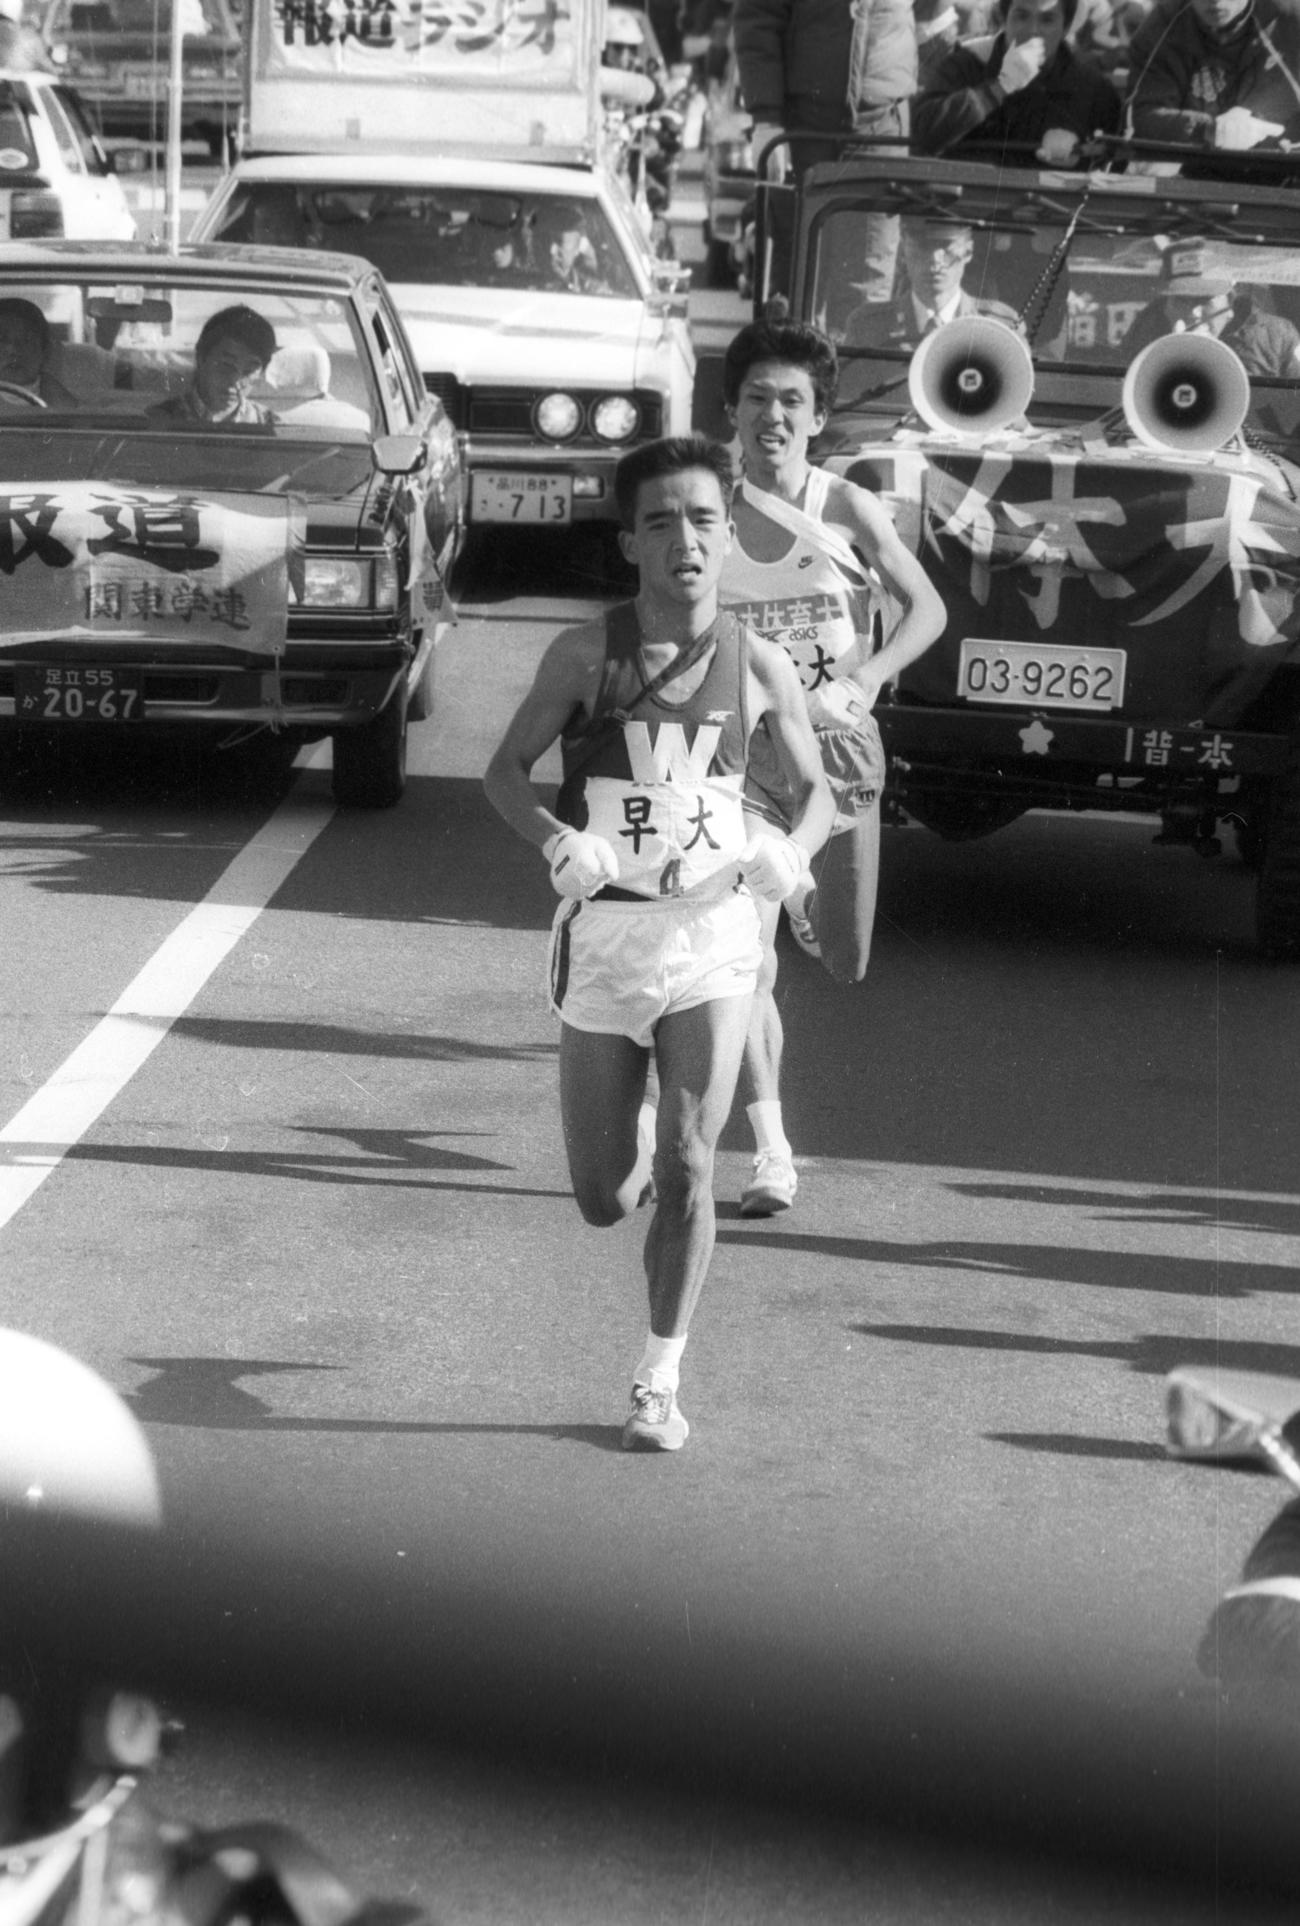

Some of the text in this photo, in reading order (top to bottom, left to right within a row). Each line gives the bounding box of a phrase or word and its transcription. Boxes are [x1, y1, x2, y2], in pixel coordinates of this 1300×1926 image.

[43, 687, 138, 719] 20-67
[967, 657, 1113, 701] 03-9262
[622, 720, 723, 783] W
[617, 794, 722, 856] 早大
